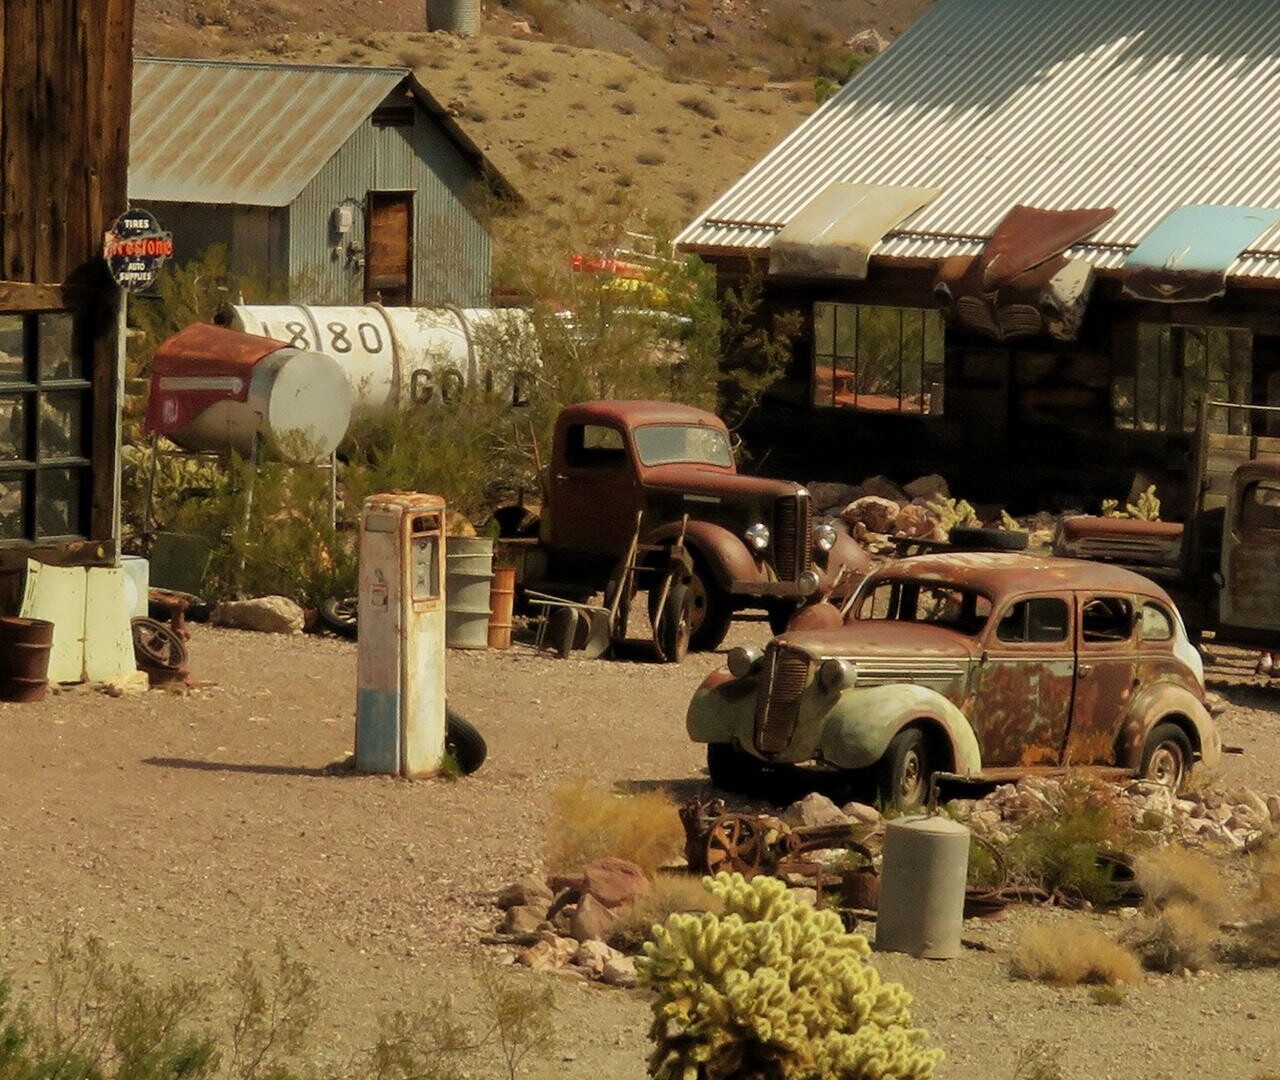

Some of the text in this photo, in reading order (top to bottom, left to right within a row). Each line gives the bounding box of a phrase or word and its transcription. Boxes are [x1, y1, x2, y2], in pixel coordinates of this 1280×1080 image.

[123, 219, 150, 230] TIRES
[127, 262, 146, 271] AUTO
[119, 271, 152, 281] SUPPLIES
